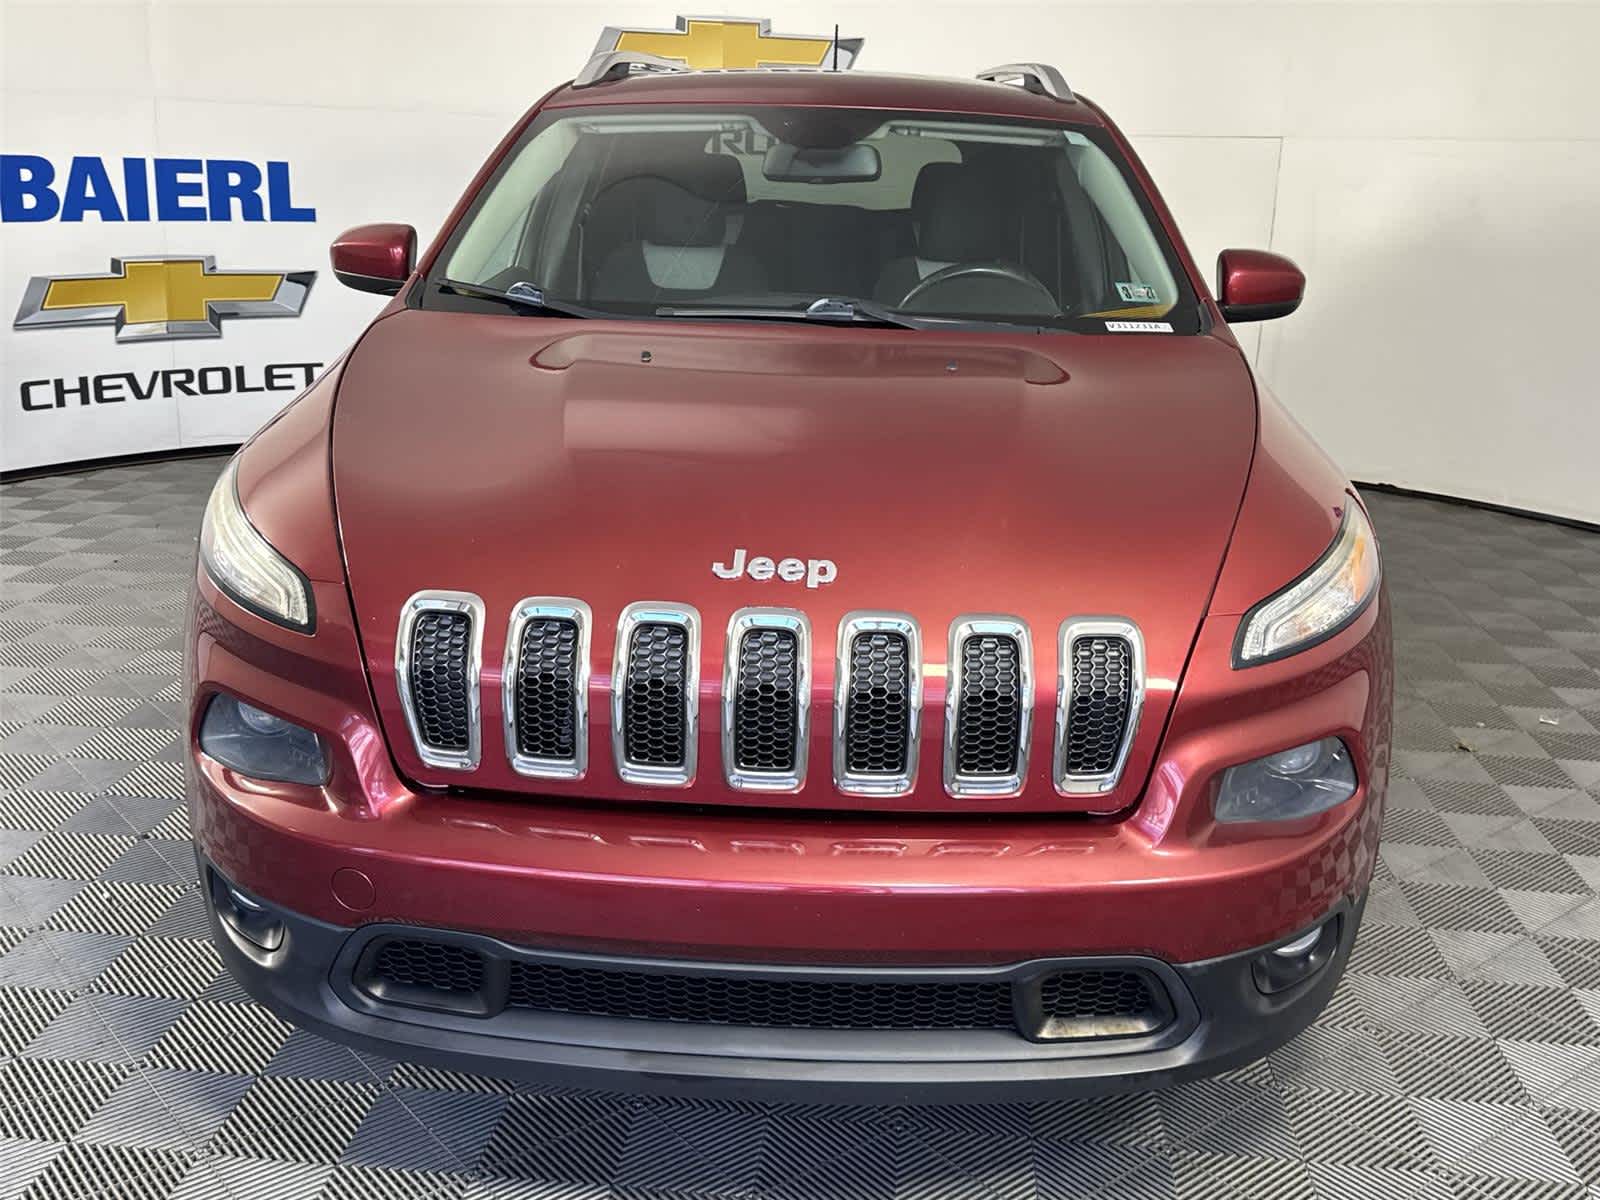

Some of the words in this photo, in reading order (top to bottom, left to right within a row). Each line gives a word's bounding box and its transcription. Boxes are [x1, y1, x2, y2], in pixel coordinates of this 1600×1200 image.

[0, 154, 316, 223] BAIERL
[20, 362, 324, 411] CHEVROLET
[711, 549, 838, 588] Jeep
